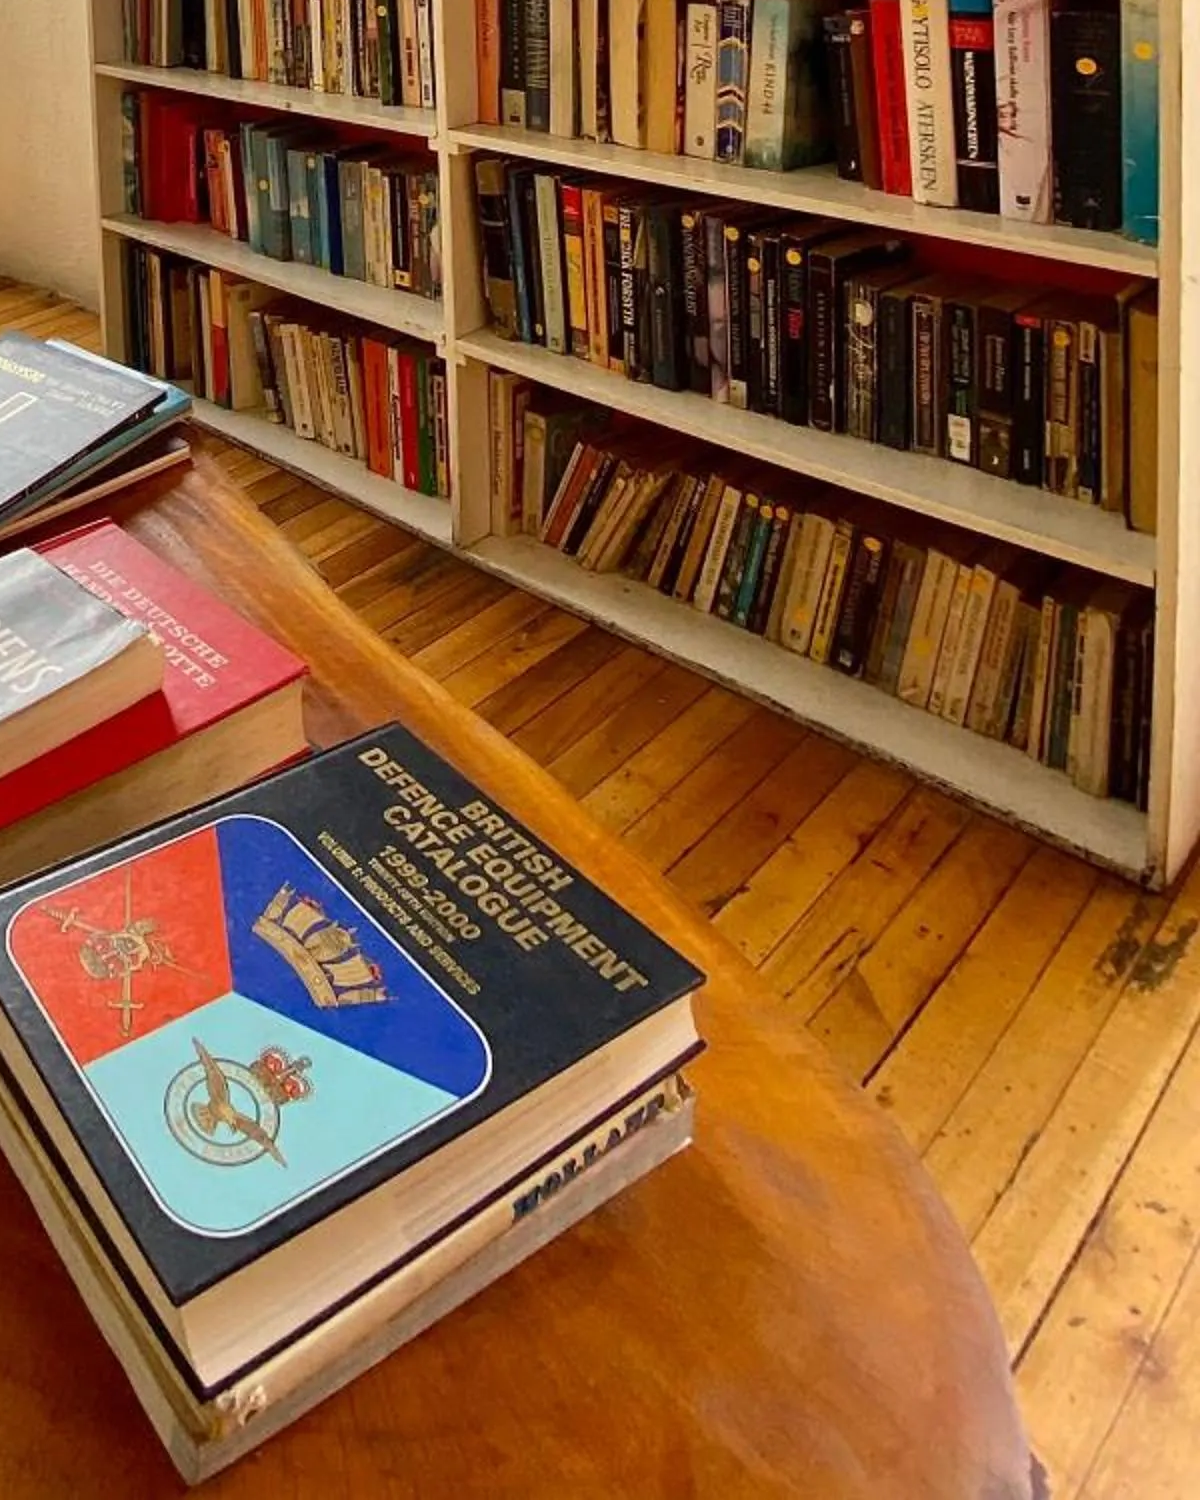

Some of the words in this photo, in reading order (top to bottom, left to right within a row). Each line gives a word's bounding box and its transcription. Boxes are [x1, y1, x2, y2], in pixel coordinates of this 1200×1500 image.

[618, 208, 634, 269] FRERICK
[620, 271, 635, 326] FORSYTH
[88, 560, 128, 588] DIE
[123, 585, 229, 670] DEUTSCHE
[358, 747, 475, 845] DEFENCE
[466, 843, 649, 993] EQUIPMENT
[378, 844, 481, 940] 1999-2000
[383, 805, 550, 952] CATALOGUE
[460, 800, 574, 892] BRITISH
[360, 874, 413, 926] PRODUCTS
[405, 923, 434, 948] AND
[428, 945, 482, 996] SERVICES
